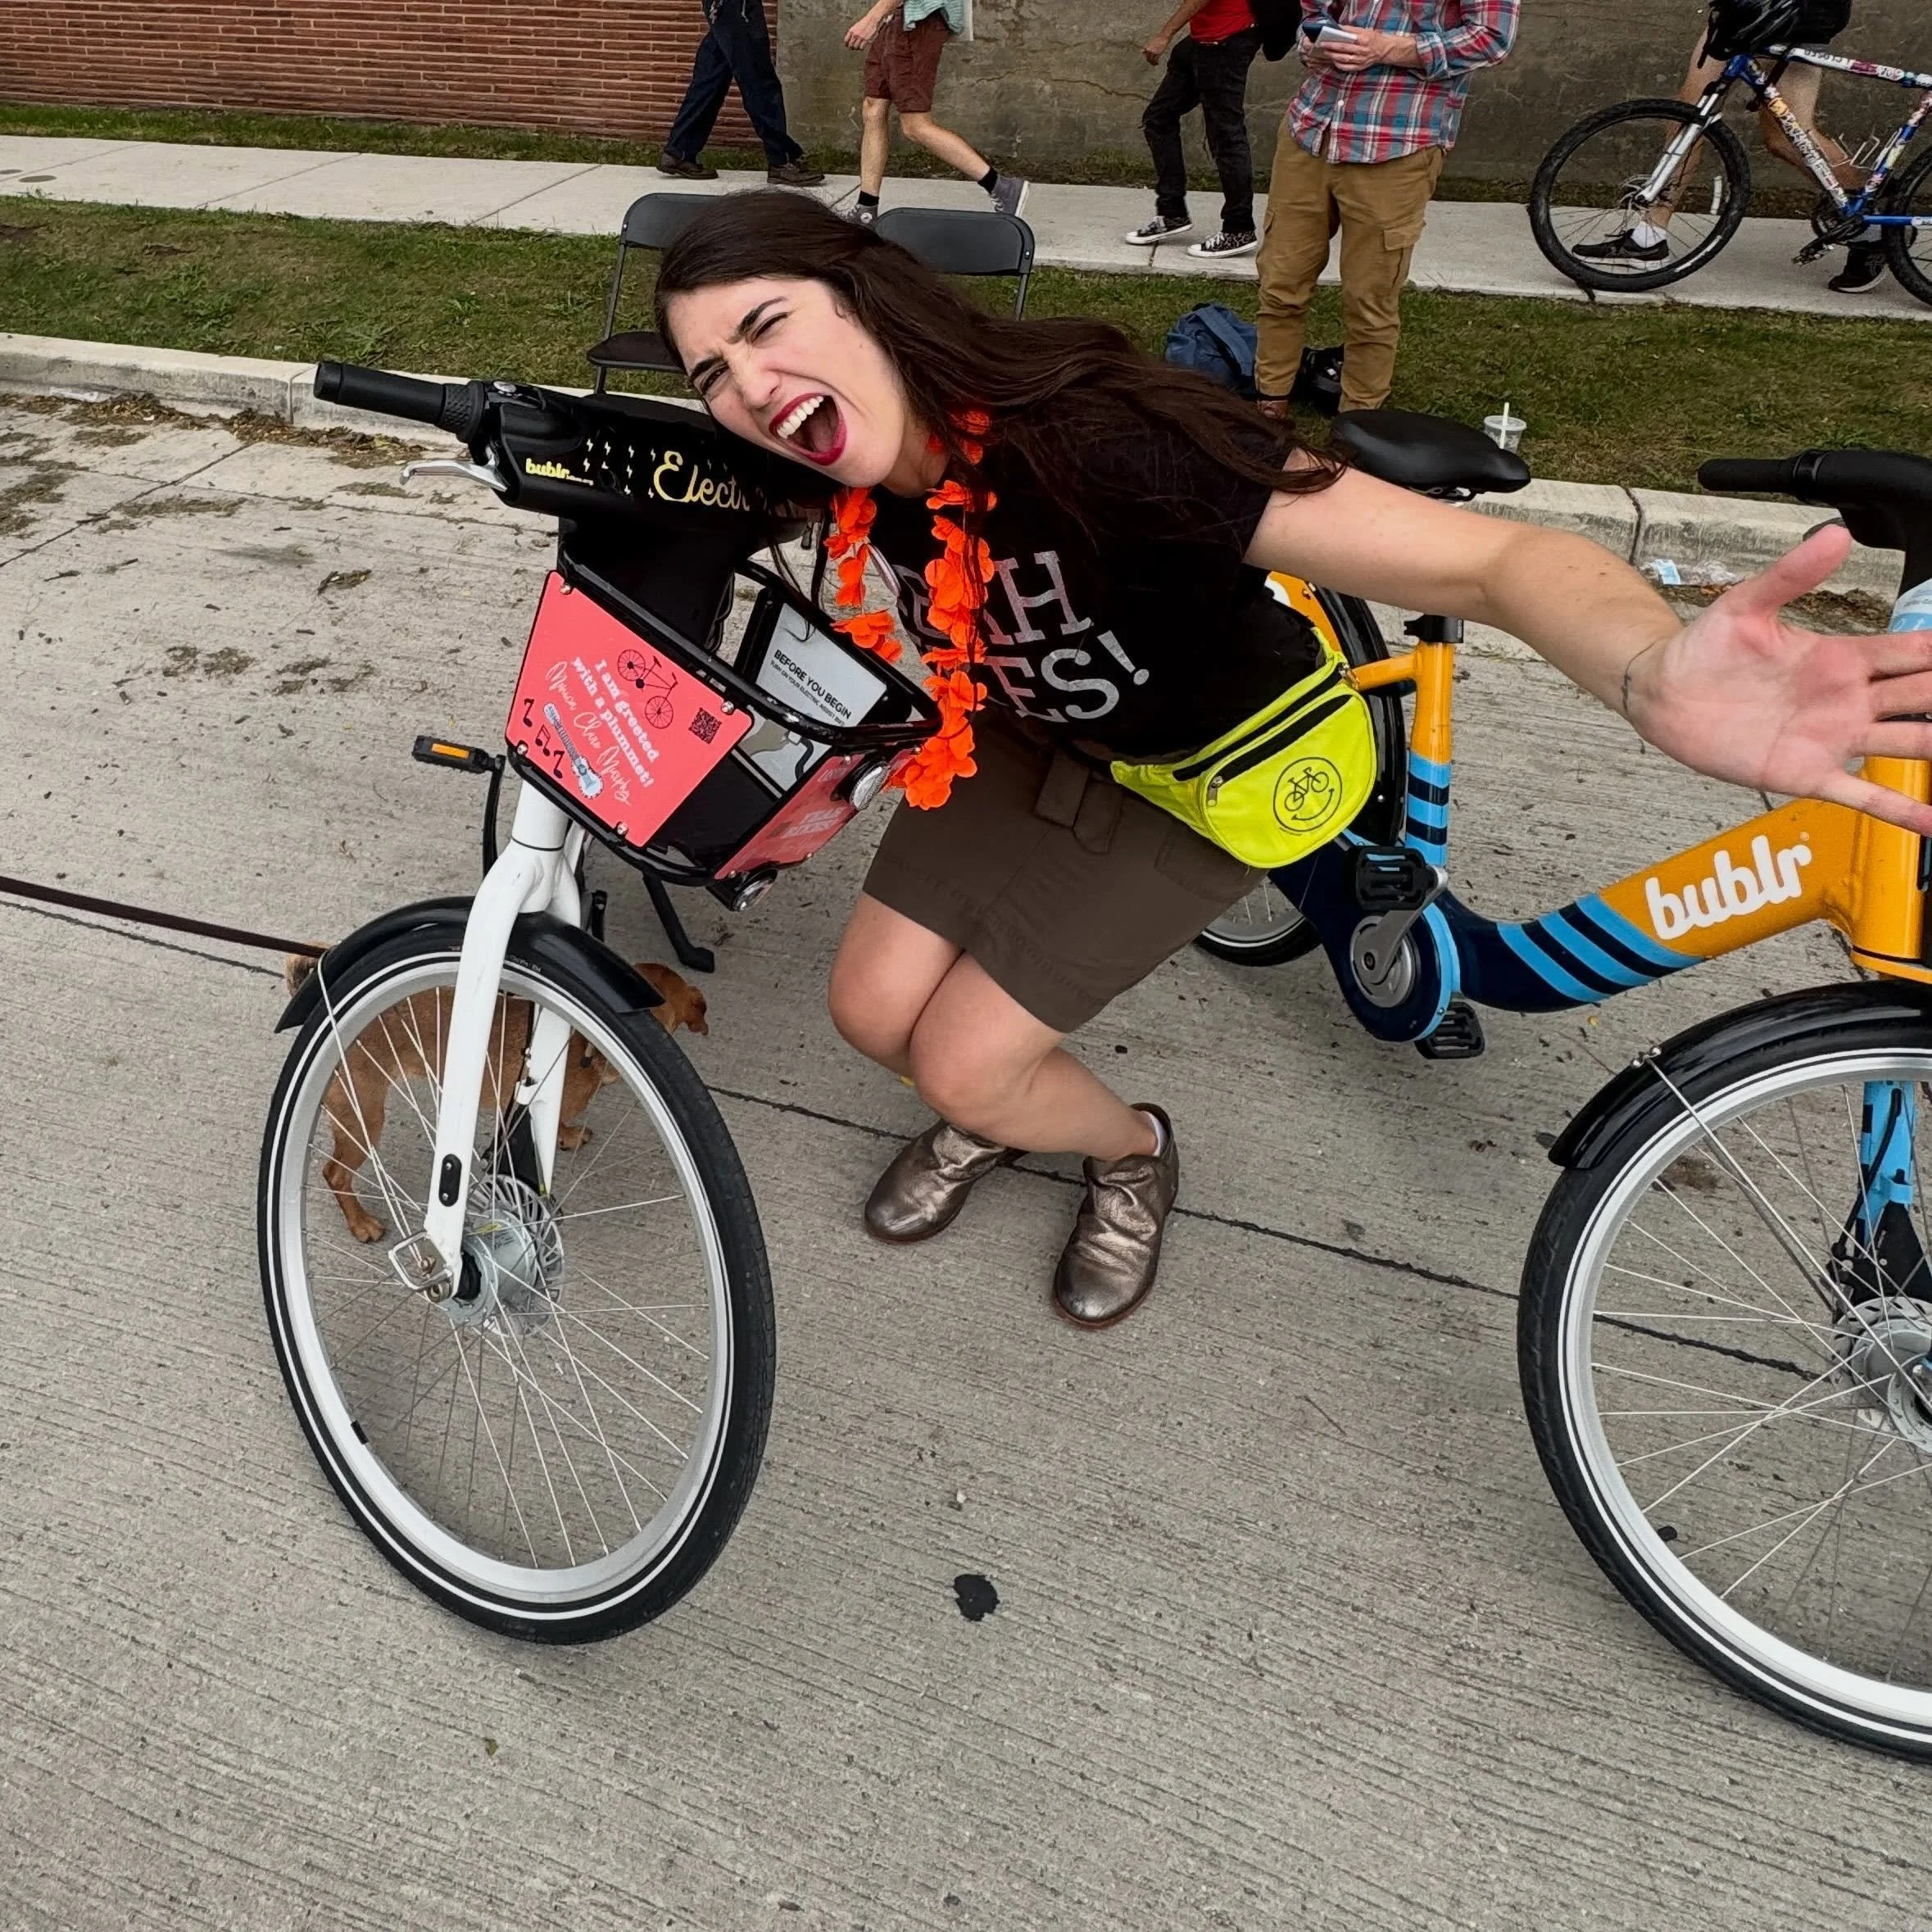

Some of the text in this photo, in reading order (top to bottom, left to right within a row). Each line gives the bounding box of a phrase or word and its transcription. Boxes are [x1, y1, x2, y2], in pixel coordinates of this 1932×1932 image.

[525, 457, 570, 479] bublr
[571, 655, 655, 788] with a plummet!
[595, 659, 660, 763] I am greeted
[773, 649, 851, 719] BEFORE YOU BEGIN
[1644, 834, 1813, 940] bublr
